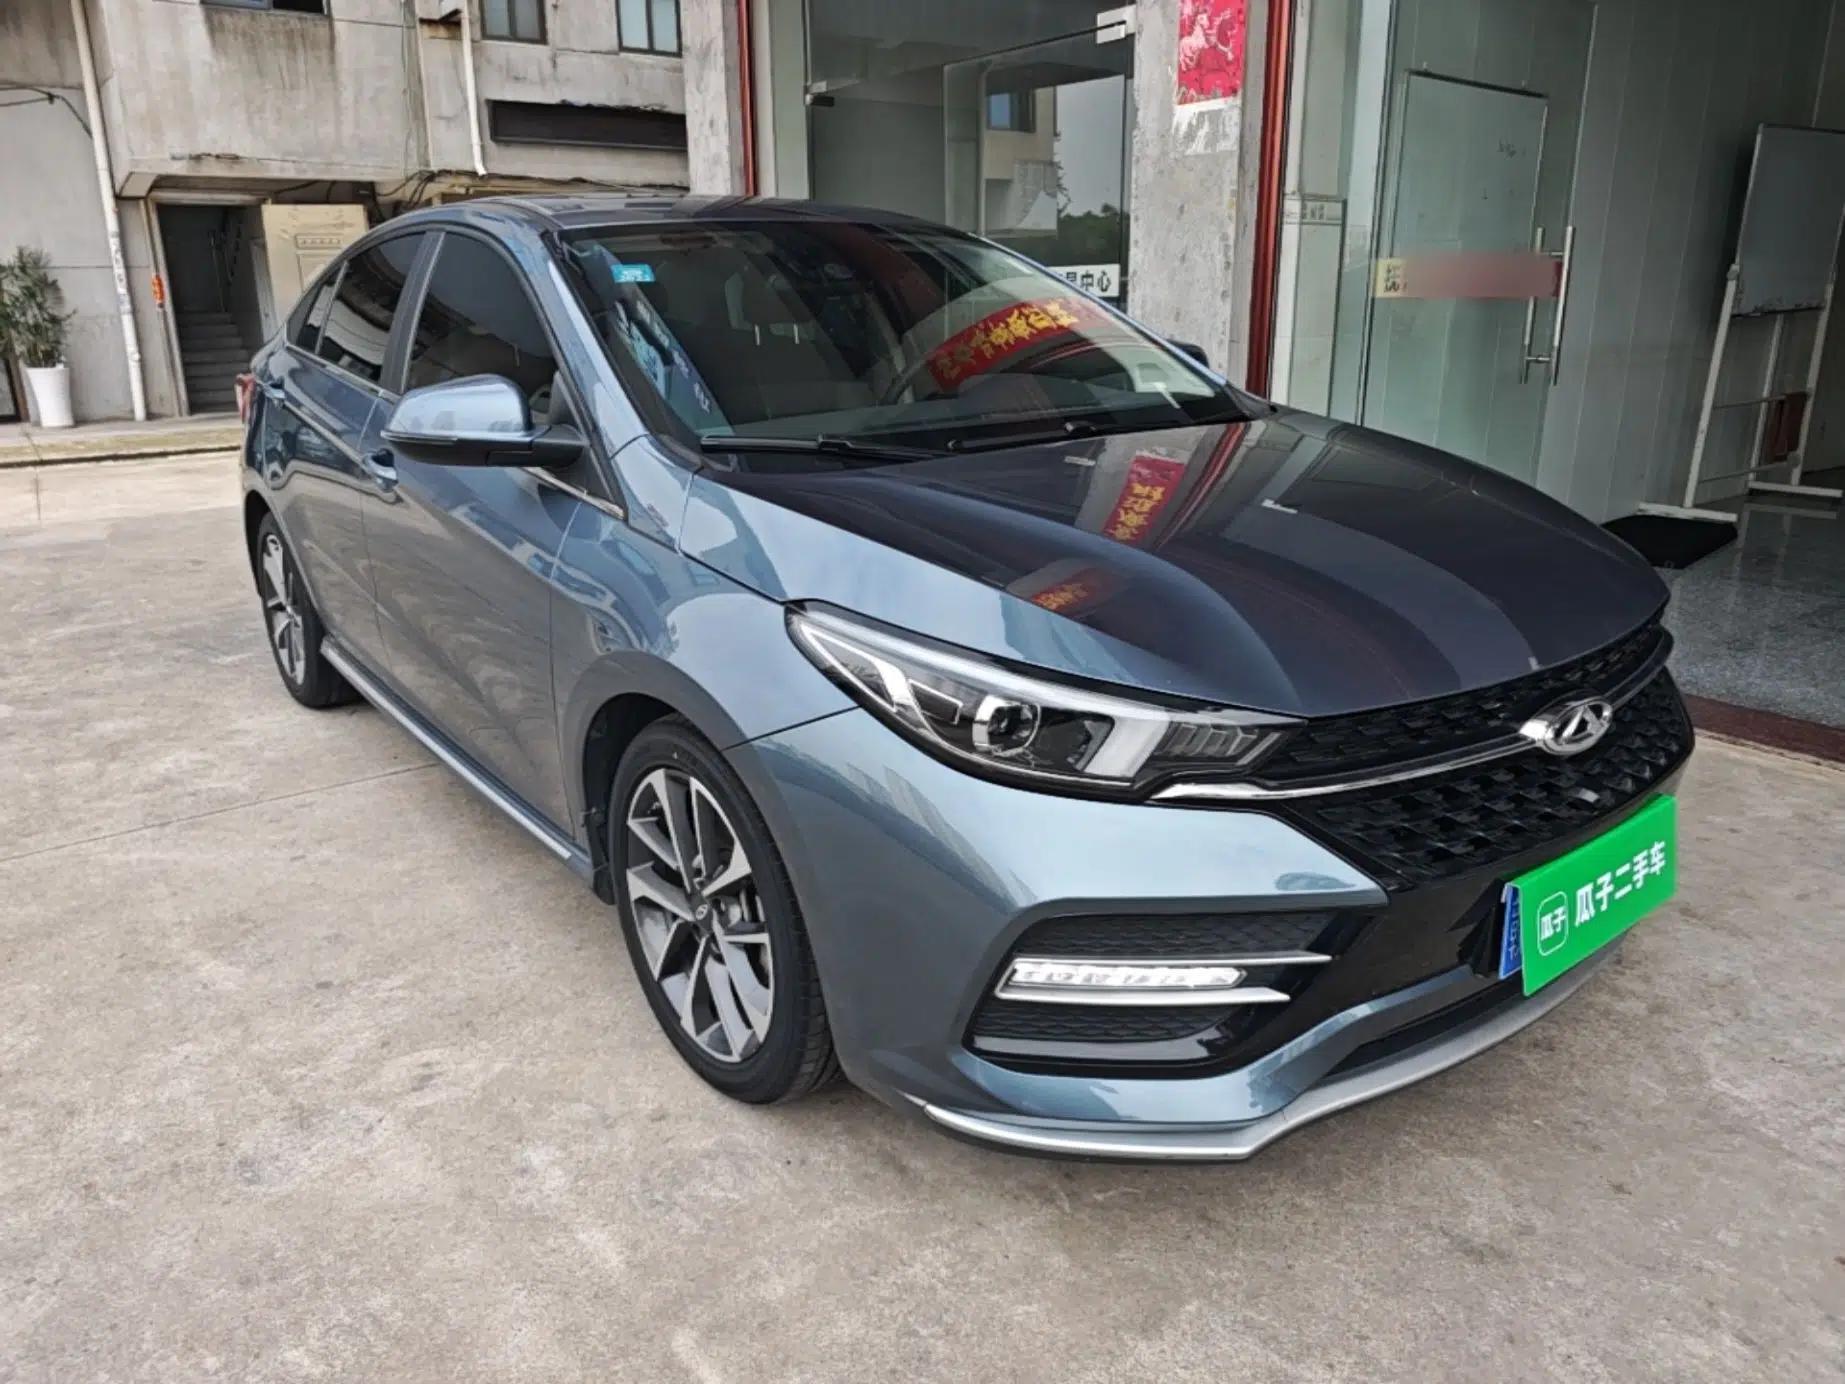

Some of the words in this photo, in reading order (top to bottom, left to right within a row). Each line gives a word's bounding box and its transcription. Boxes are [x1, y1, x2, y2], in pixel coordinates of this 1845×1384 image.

[1575, 841, 1666, 927] 瓜子二手车
[1540, 906, 1567, 941] 瓜子
